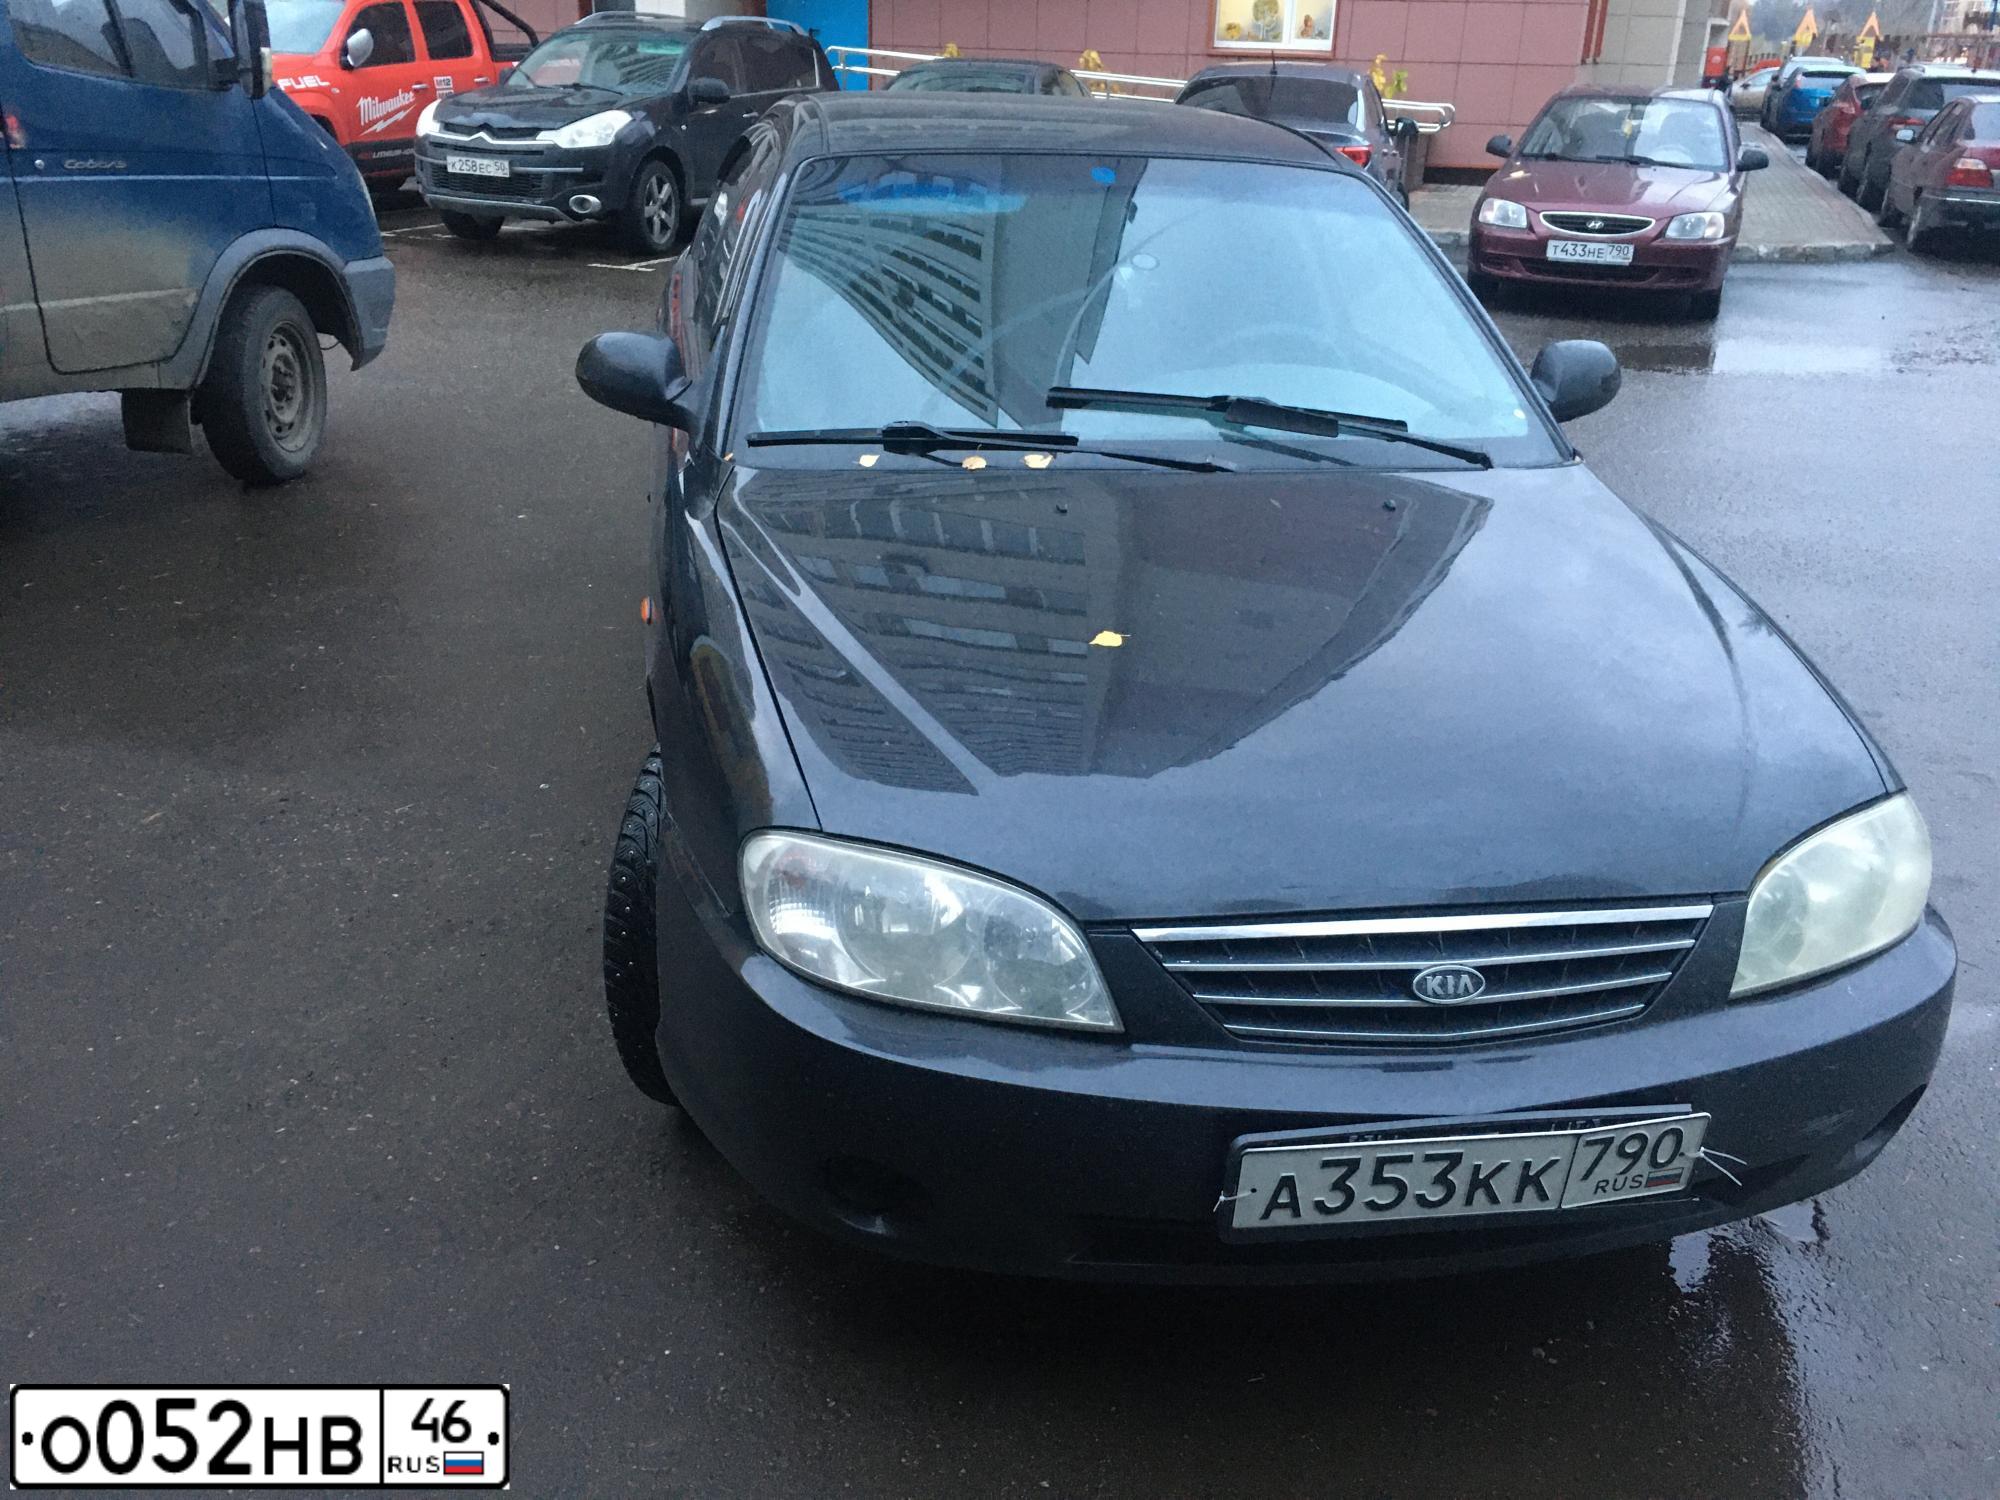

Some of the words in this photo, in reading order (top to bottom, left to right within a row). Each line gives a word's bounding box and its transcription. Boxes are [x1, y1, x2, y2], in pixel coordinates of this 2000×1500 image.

[277, 75, 330, 91] FUEL
[356, 89, 416, 126] Milwaukee
[1552, 242, 1605, 259] Т433НЕ
[1608, 244, 1630, 256] 790
[1425, 974, 1475, 996] KIA
[1259, 1152, 1561, 1220] А353КК
[1580, 1127, 1685, 1182] 790
[1593, 1174, 1645, 1195] RUS
